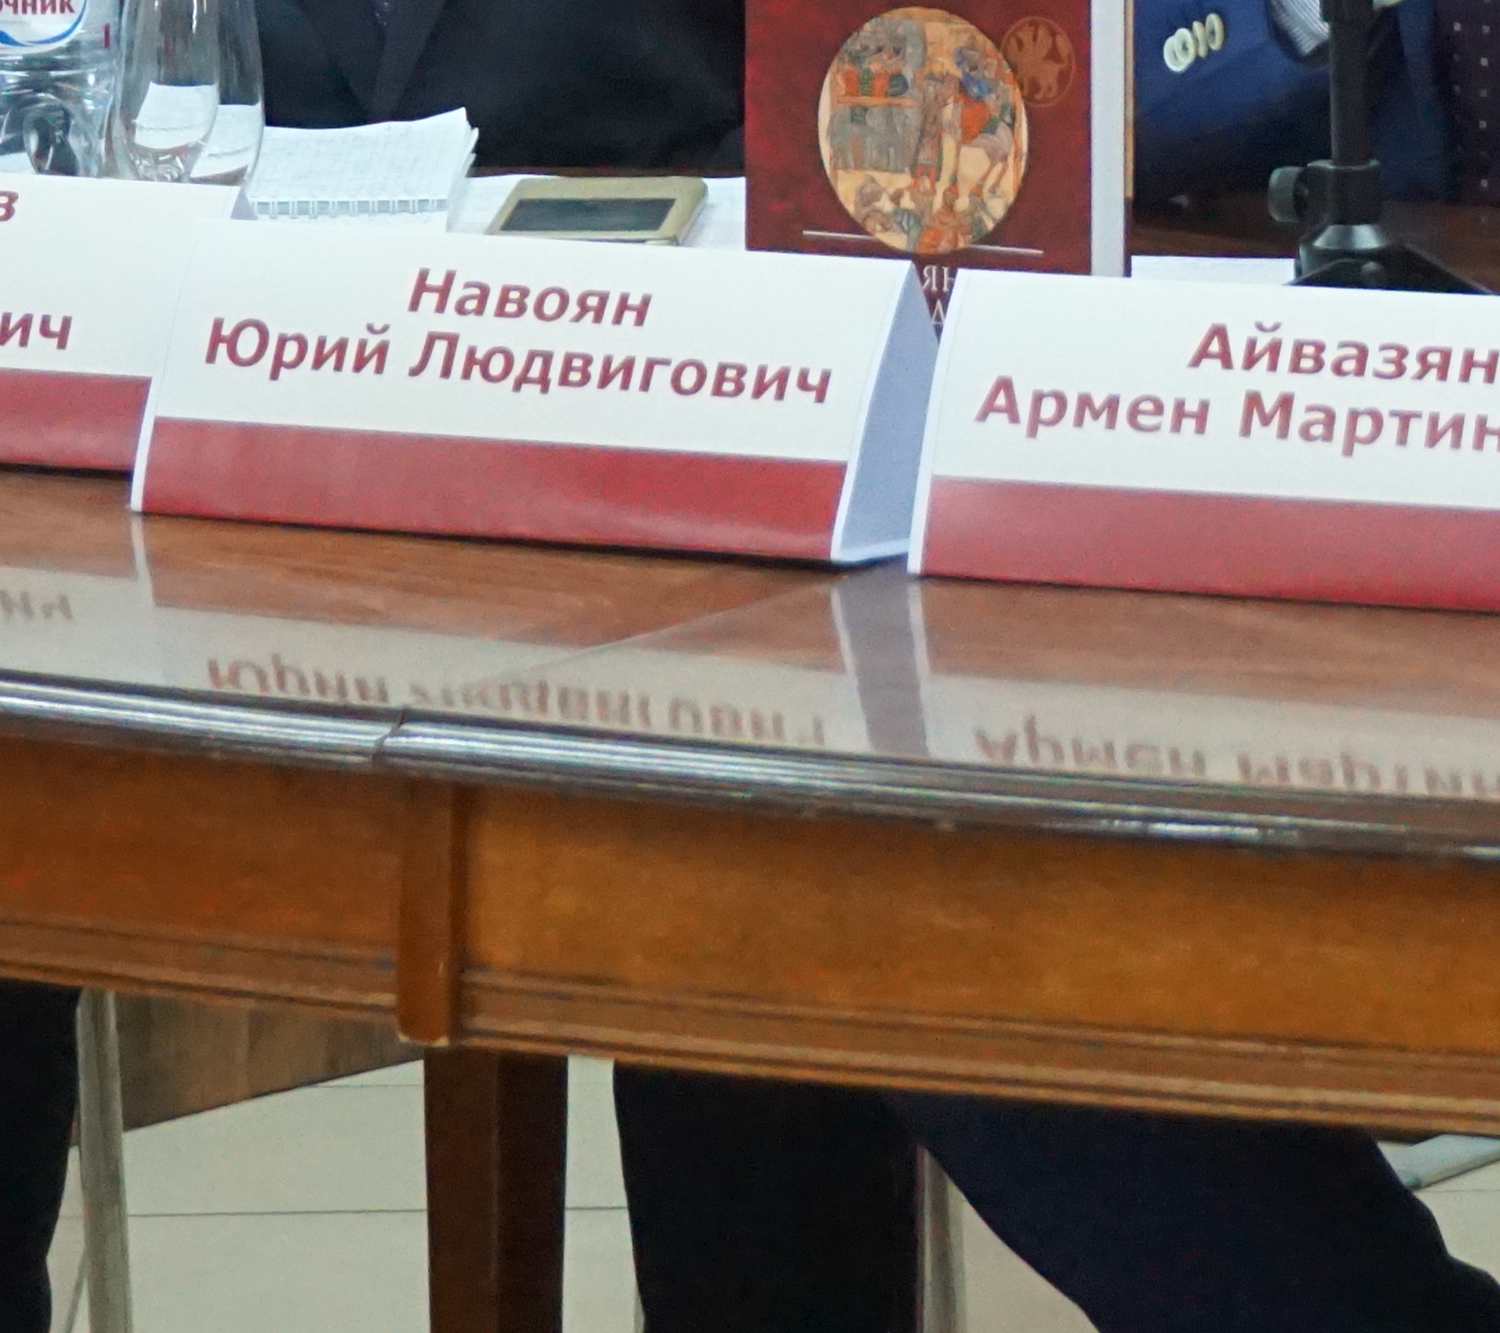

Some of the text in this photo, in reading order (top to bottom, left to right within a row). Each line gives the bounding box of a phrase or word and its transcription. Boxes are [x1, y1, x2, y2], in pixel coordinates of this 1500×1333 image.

[408, 268, 652, 327] Навоян
[205, 318, 831, 404] Юрий Людвигович
[1188, 323, 1499, 384] Айвазян
[976, 377, 1210, 438] Армен
